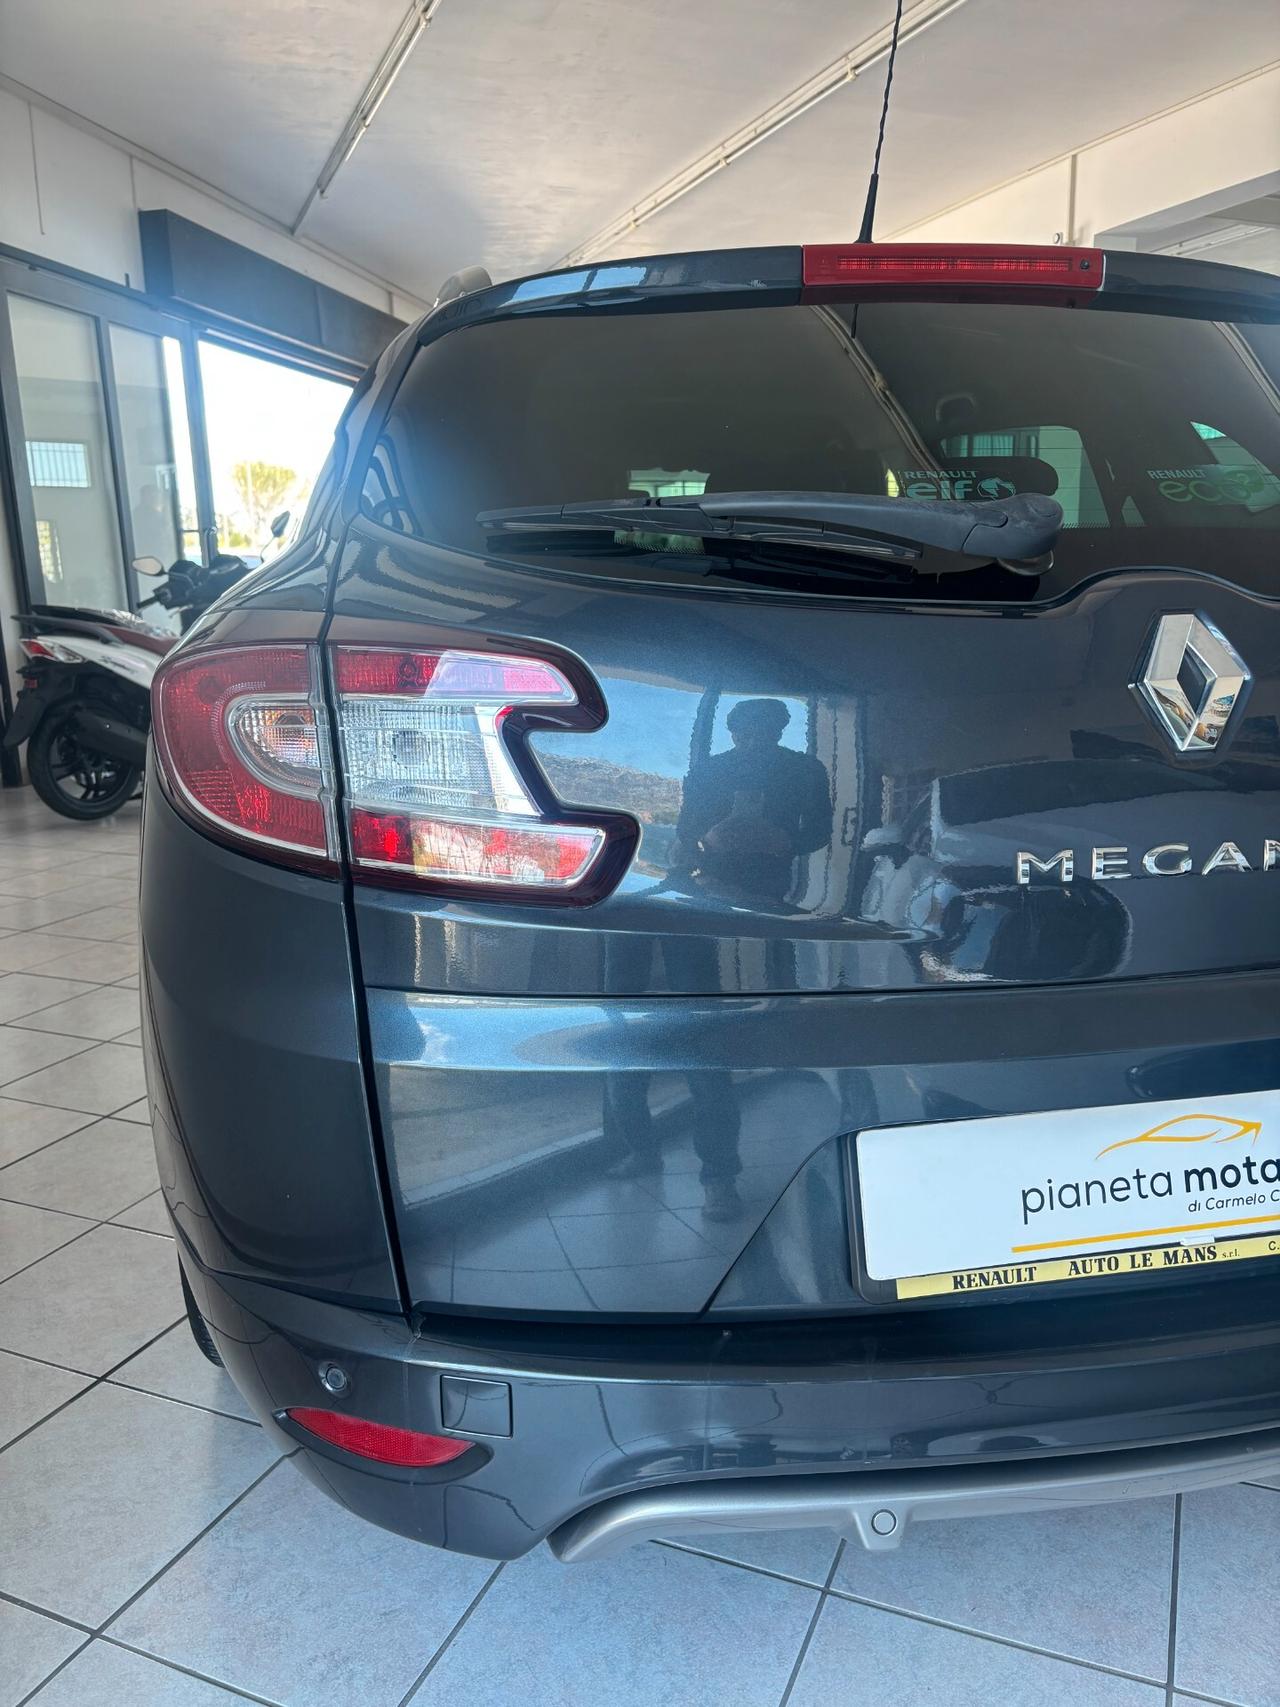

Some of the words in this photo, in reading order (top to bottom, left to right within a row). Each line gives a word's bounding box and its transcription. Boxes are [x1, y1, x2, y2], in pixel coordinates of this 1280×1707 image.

[903, 470, 979, 480] RENAULT
[1146, 468, 1208, 480] RENAULT
[906, 480, 974, 500] elf
[1021, 1169, 1173, 1225] pianeta
[1188, 1200, 1201, 1212] di
[1205, 1193, 1266, 1211] Carmelo
[952, 1266, 1037, 1290] RENAULT
[1068, 1256, 1119, 1276] AUTO
[1130, 1253, 1153, 1268] LE
[1163, 1245, 1217, 1265] MANS
[1222, 1248, 1240, 1259] s.r.l.
